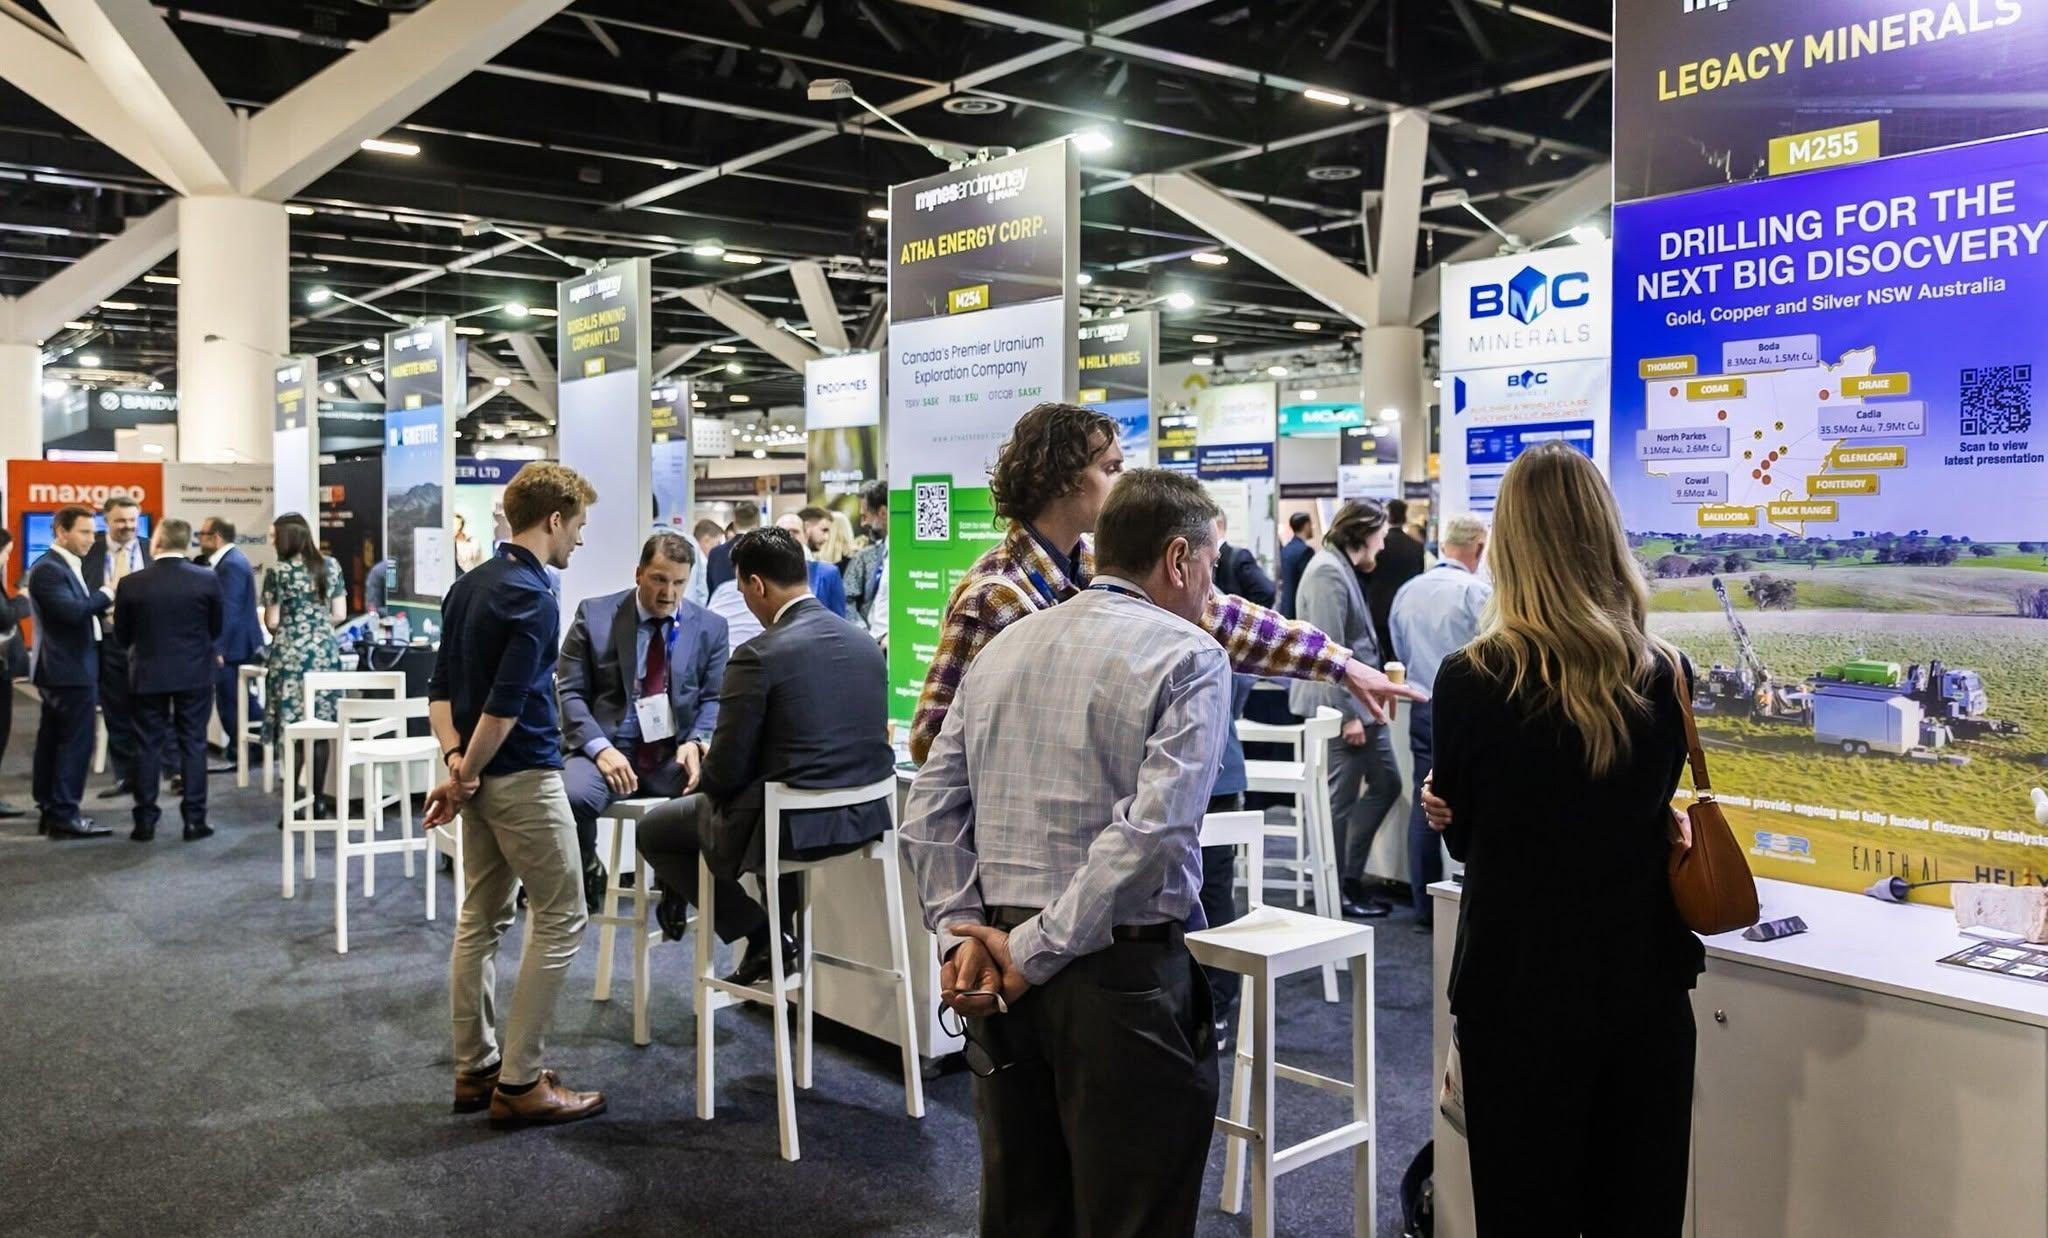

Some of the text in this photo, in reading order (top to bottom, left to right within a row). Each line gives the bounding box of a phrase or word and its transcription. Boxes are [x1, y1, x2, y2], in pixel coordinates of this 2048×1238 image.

[1658, 0, 2022, 101] LEGACY MINERALS
[1788, 130, 1859, 165] M255
[1660, 180, 2016, 261] DRILLING FOR THE
[901, 215, 1047, 265] ATHA ENERGY CORP.
[1637, 219, 2048, 302] NEXT BIG DISOCVERY
[1666, 275, 2006, 327] Gold, Copper and Silver NSW Australia
[1468, 323, 1591, 353] MINERALS
[902, 335, 1044, 366] Canada's Premier Uranium
[1758, 342, 1780, 351] Boda
[1086, 354, 1107, 369] HILL
[1109, 351, 1141, 367] MINES
[1801, 352, 1813, 361] Cu
[1646, 361, 1688, 372] THOMSON
[914, 360, 1028, 387] Exploration Company
[1700, 383, 1729, 394] COBAR
[1858, 379, 1890, 390] DRAKE
[1856, 409, 1881, 419] Cadia
[1820, 421, 1920, 435] 35.5Moz Au, 7.9Mt Cu
[1657, 432, 1706, 442] North Parkes
[1711, 443, 1721, 452] Cu
[1959, 440, 2028, 452] Scan to view
[1839, 453, 1897, 463] GLENLOGAN
[1945, 452, 2044, 466] latest presentation
[478, 467, 501, 478] LTD
[1684, 476, 1709, 485] Cowal
[1816, 479, 1867, 489] FONTENOY
[28, 482, 146, 511] maxgeo
[1707, 488, 1718, 497] Au
[1771, 504, 1832, 515] BLACK RANGE
[1753, 799, 1792, 813] provide
[1794, 803, 1837, 820] ongoing
[1839, 809, 1860, 821] and
[1862, 810, 1888, 826] fully
[1890, 814, 1930, 830] funded
[1932, 820, 1991, 840] discovery
[1853, 846, 1939, 880] EARTH AI
